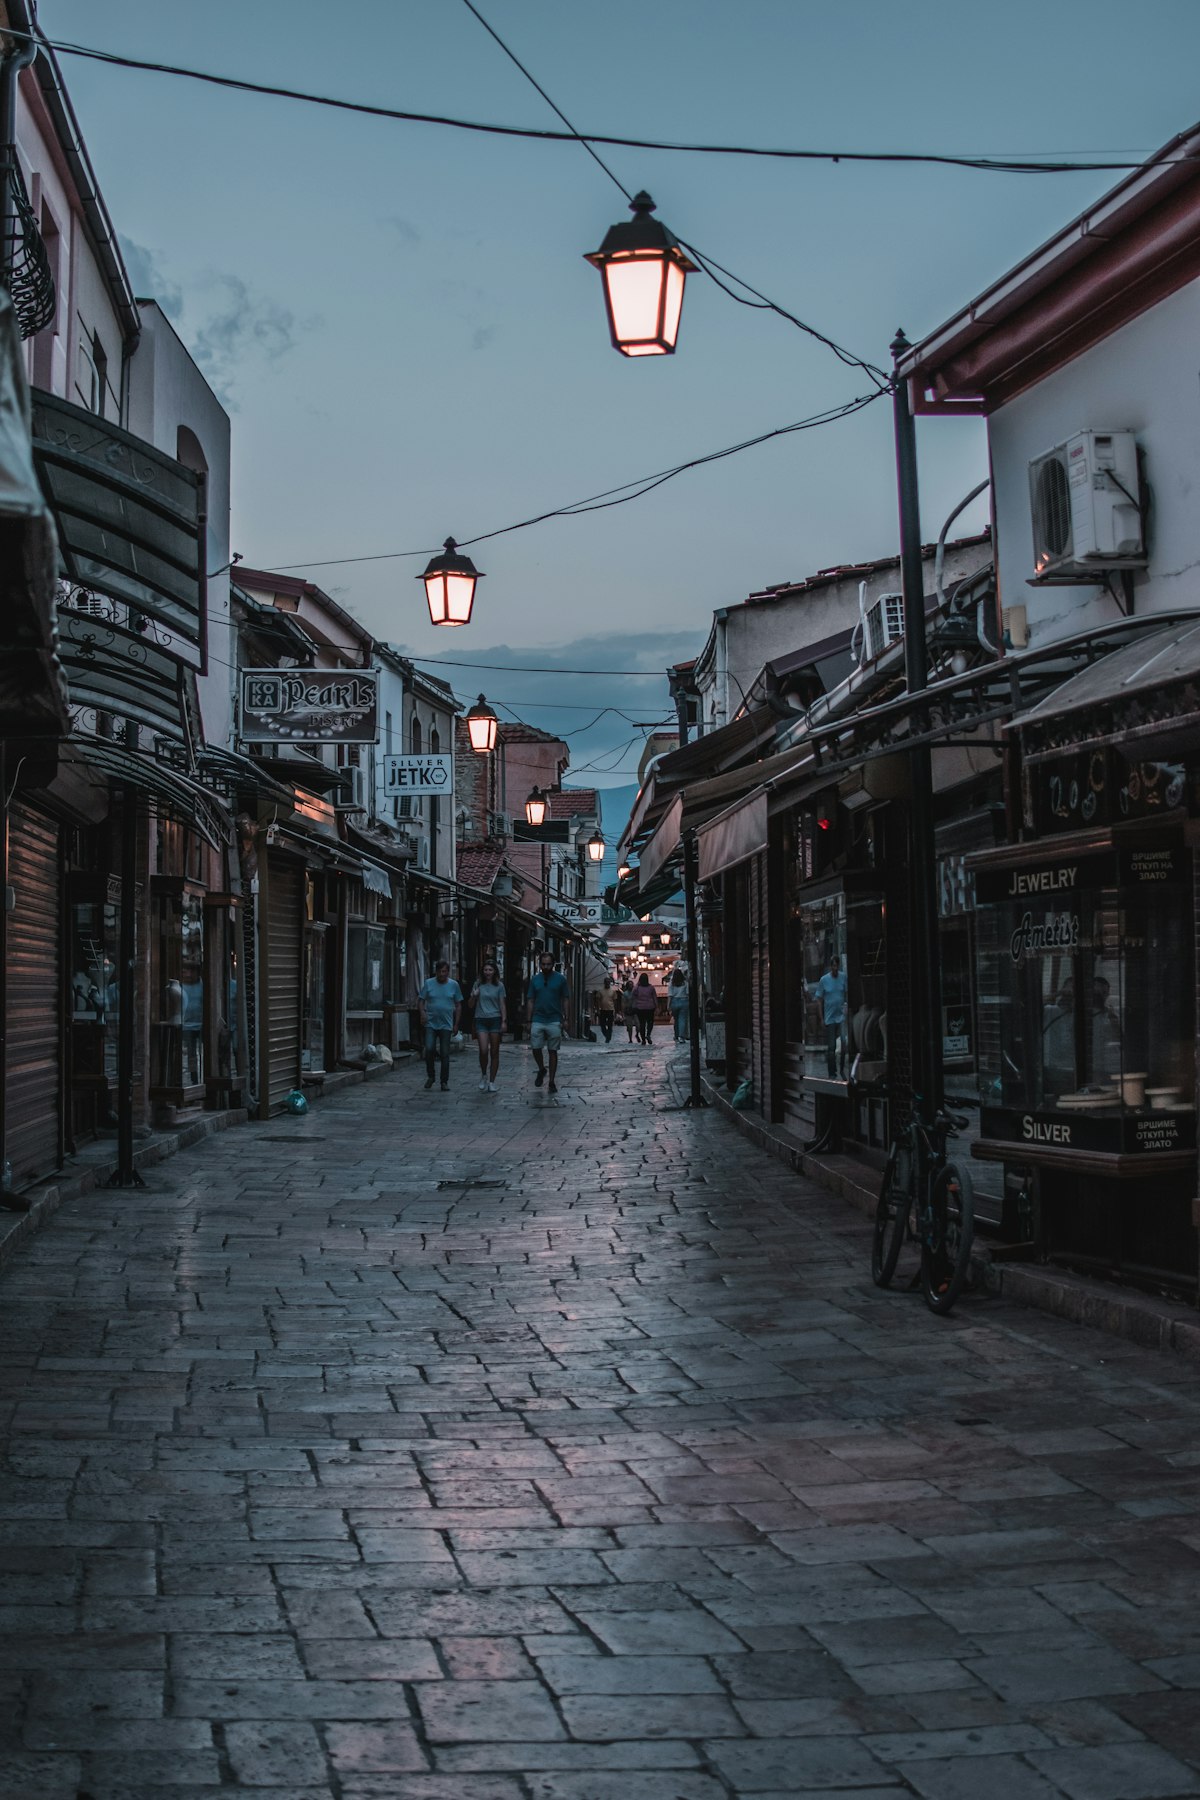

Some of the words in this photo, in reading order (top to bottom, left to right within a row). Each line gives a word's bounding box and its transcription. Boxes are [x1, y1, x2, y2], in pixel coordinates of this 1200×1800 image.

[252, 683, 275, 695] KO
[252, 695, 275, 706] KA
[283, 679, 375, 713] Pearls
[391, 759, 443, 767] SILVER
[1132, 850, 1171, 860] ВРШИМЕ
[1130, 861, 1159, 870] ОТКУП
[1160, 861, 1174, 870] НА
[1139, 871, 1167, 880] ЗЛАТО
[1010, 911, 1079, 962] Ametist
[1137, 1119, 1176, 1129] ВРШИМЕ
[1135, 1130, 1165, 1140] ОТКУП
[1165, 1129, 1179, 1138] НА
[1143, 1139, 1172, 1149] ЗЛАТО
